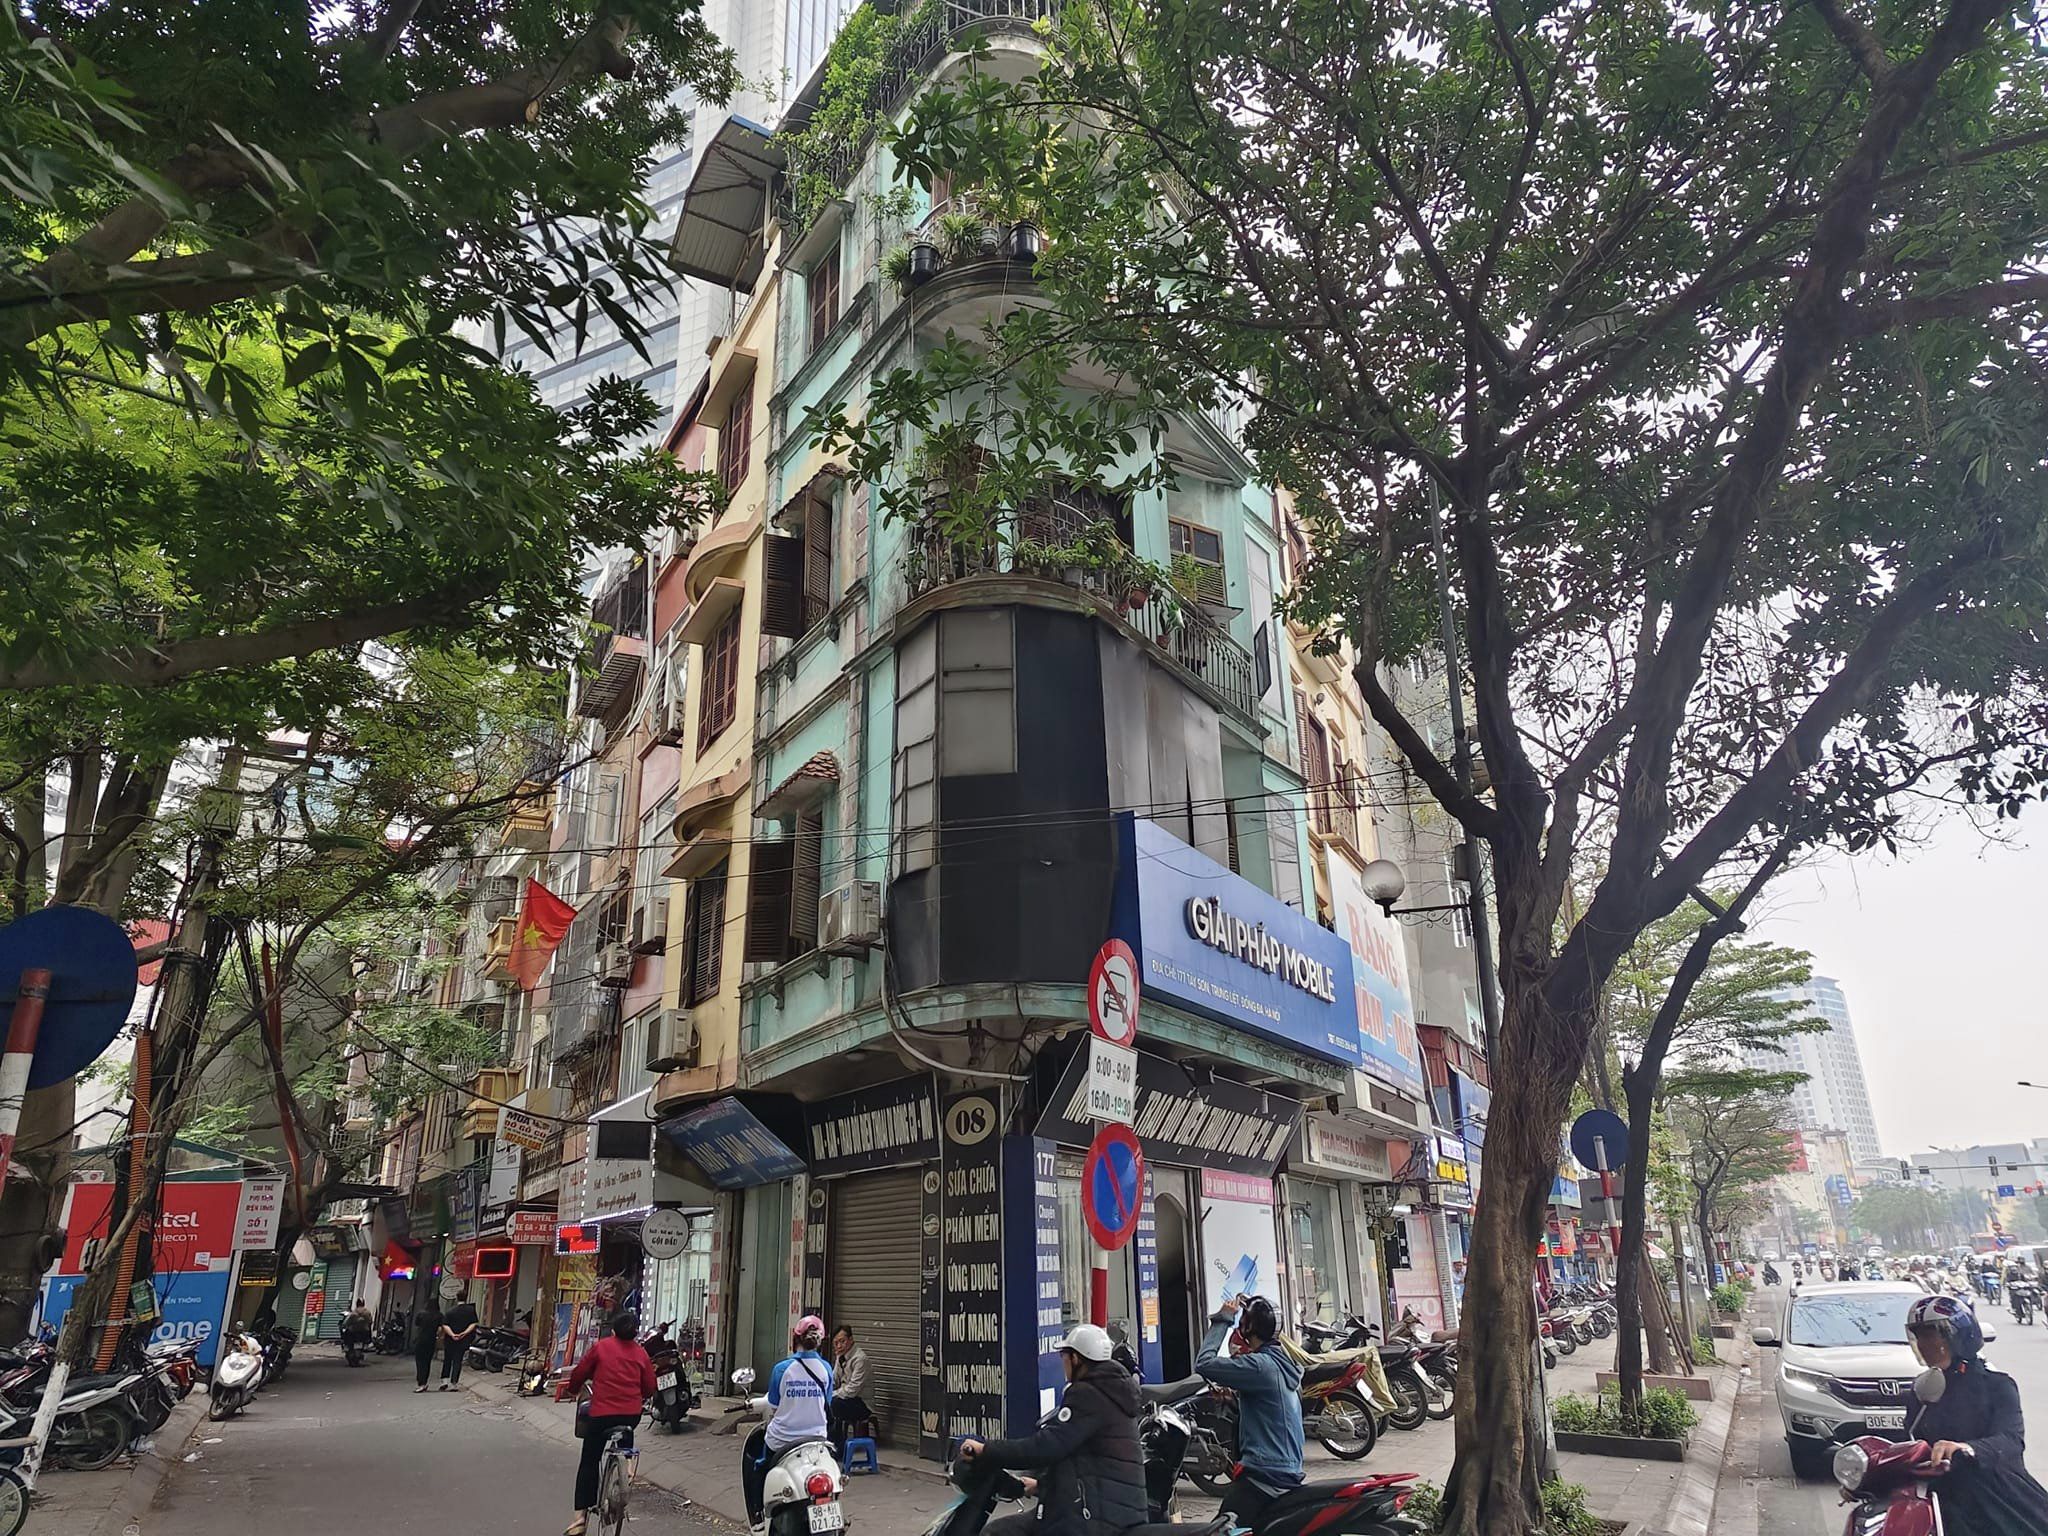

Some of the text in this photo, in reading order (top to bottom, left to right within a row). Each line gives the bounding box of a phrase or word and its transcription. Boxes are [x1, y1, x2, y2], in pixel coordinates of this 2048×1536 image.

[1191, 895, 1336, 1003] GIẢI PHÁP MOBILE
[1096, 1055, 1131, 1083] 6:00 9:00
[1091, 1089, 1132, 1117] 16:00 19:30
[506, 1111, 530, 1125] MUA
[955, 1107, 987, 1136] 08
[1036, 1151, 1055, 1177] 177
[160, 1211, 200, 1228] tel
[247, 1216, 261, 1228] SỐ
[945, 1208, 972, 1245] PHẦN
[974, 1204, 1000, 1242] MỀM
[970, 1263, 999, 1297] DỤNG
[1213, 1258, 1230, 1280] Galaxy
[967, 1313, 999, 1349] MẠNG
[786, 1388, 806, 1398] CÔNG
[946, 1365, 969, 1400] NHẠC
[970, 1358, 1002, 1396] CHUÔNG
[811, 1514, 842, 1532] 021.23
